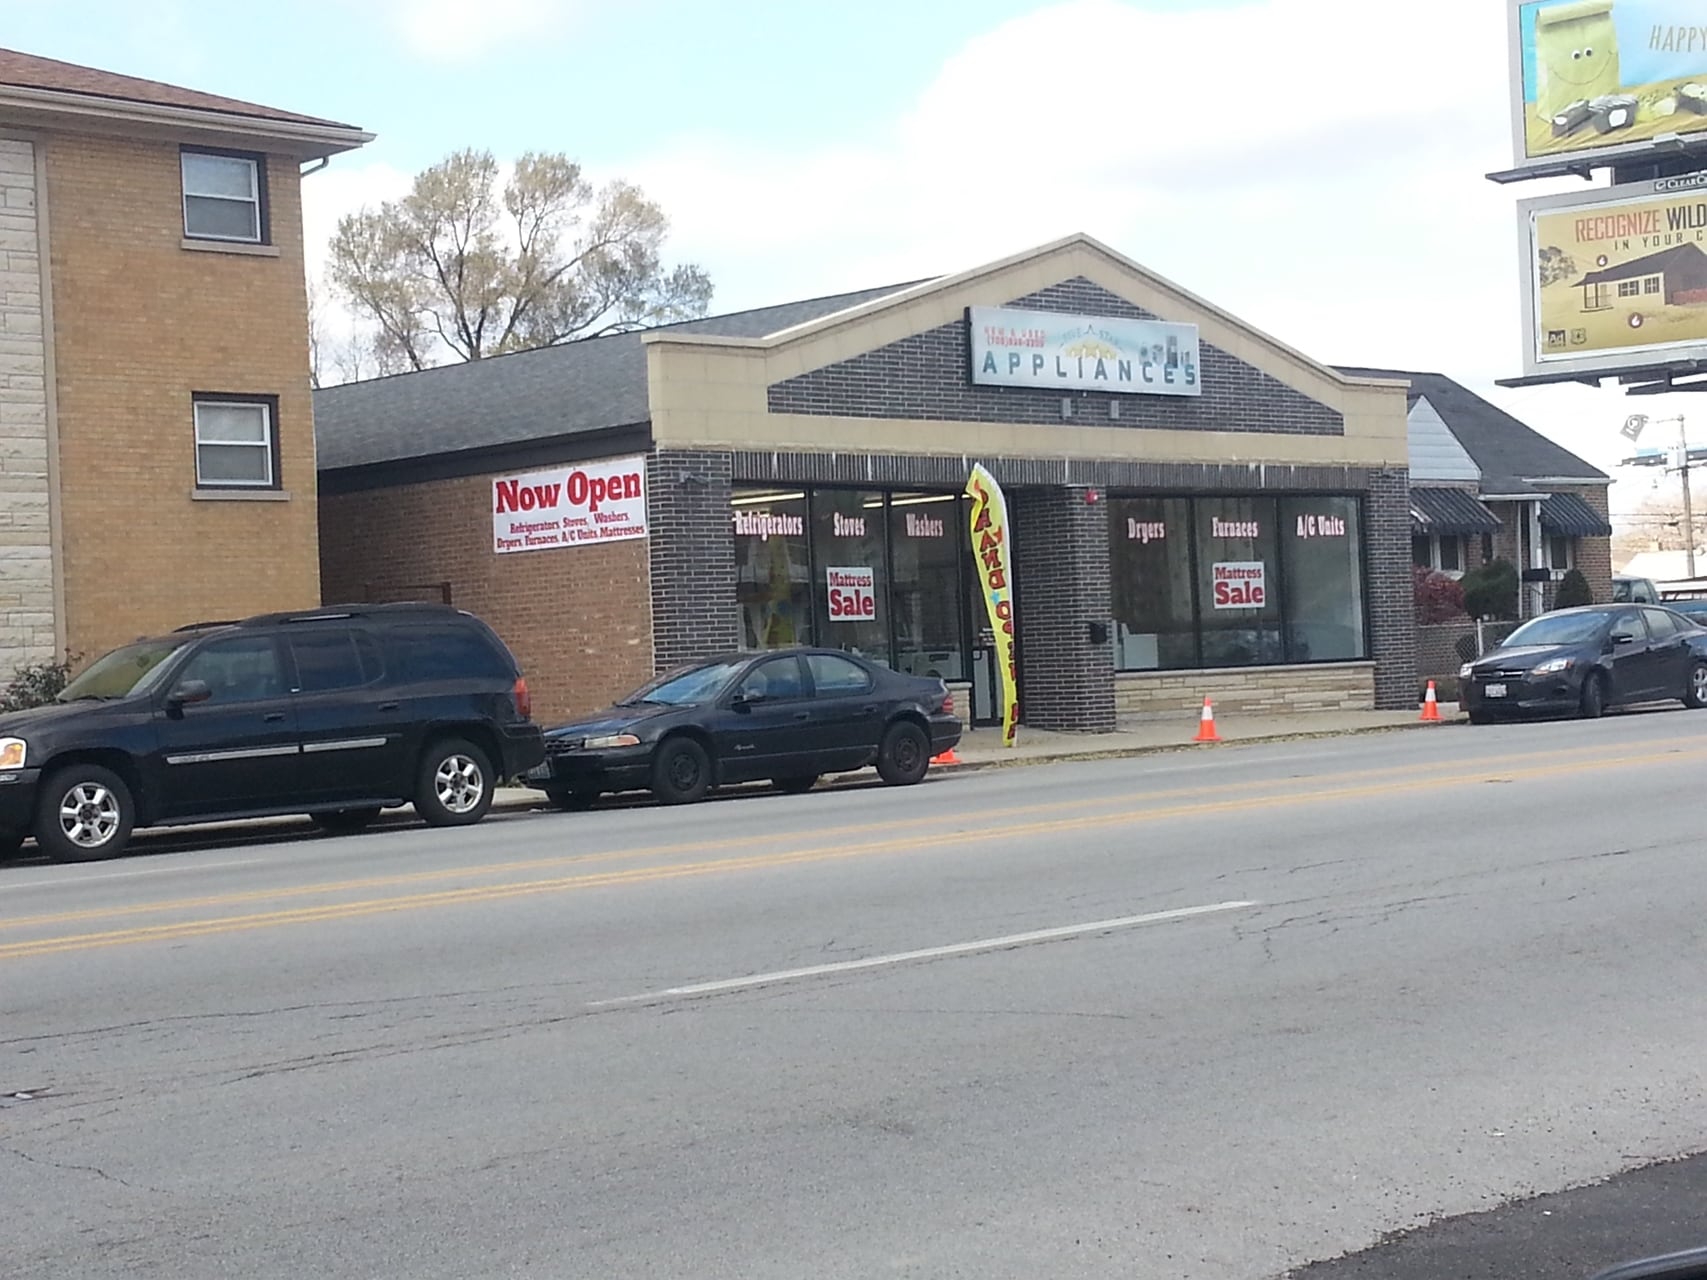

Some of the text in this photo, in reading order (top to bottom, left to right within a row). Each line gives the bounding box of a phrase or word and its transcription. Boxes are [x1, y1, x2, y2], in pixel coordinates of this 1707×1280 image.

[1649, 24, 1707, 53] HAPPY
[1575, 209, 1661, 243] RECOGNIZE
[1614, 239, 1629, 251] IN
[1642, 232, 1683, 248] YOUR
[982, 350, 1196, 386] APPLIANCES
[495, 470, 641, 514] Now Open
[599, 525, 645, 538] Mattresses
[735, 510, 803, 542] Refrigerators
[833, 511, 865, 537] Stoves
[905, 513, 943, 537] Washers
[1127, 517, 1165, 544] Dryers
[1212, 516, 1259, 538] Furnaces
[1296, 515, 1345, 539] A/C Units
[829, 571, 872, 587] Mattress
[1214, 567, 1262, 580] Mattress
[830, 589, 874, 616] Sale
[1214, 581, 1264, 605] Sale
